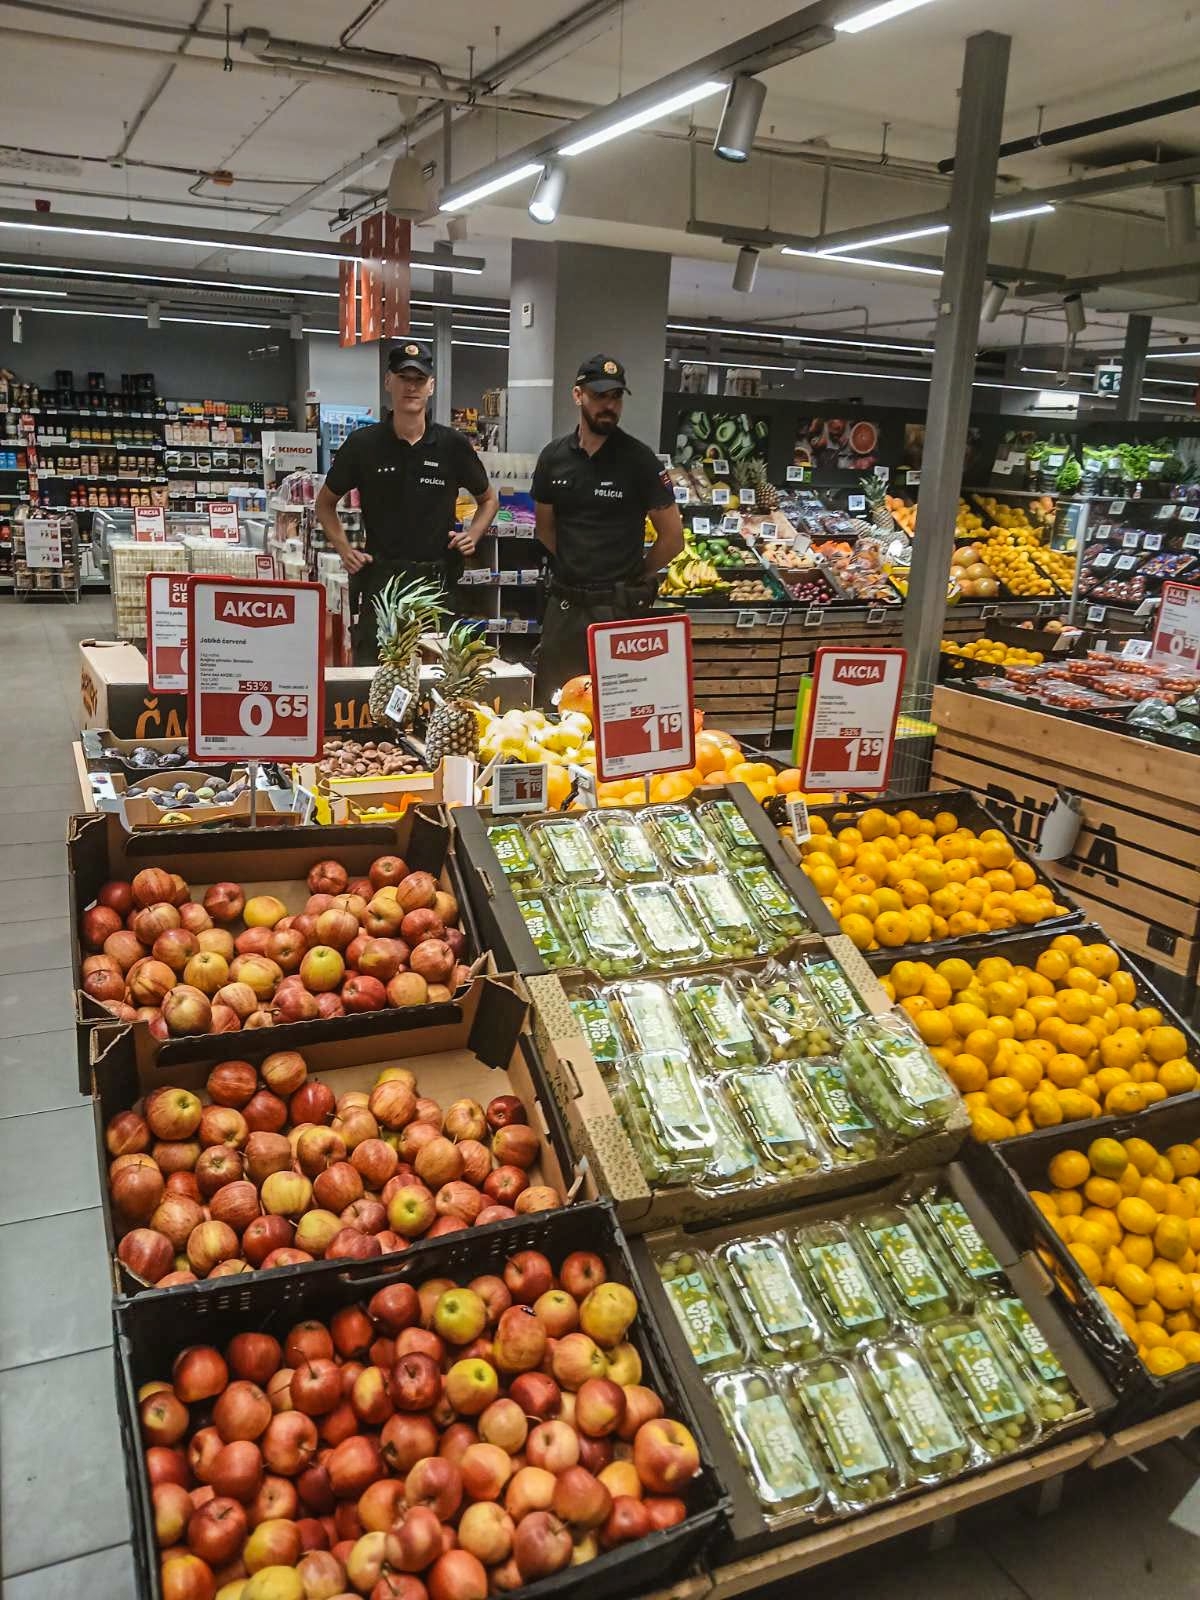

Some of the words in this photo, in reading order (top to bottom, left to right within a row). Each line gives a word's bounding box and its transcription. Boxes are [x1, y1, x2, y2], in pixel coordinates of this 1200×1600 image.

[420, 477, 445, 486] POLÍCIA
[594, 488, 623, 498] POLÍCIA
[222, 600, 288, 619] AKCIA
[616, 637, 664, 655] AKCIA
[1170, 635, 1183, 655] 0
[837, 665, 880, 679] AKCIA
[240, 681, 268, 691] -53%
[136, 697, 188, 739] ČA
[239, 693, 273, 737] 0
[275, 695, 308, 718] 65
[631, 705, 654, 716] -54%
[642, 715, 660, 752] 1
[660, 713, 682, 734] 19
[844, 739, 860, 772] 1
[860, 739, 883, 756] 39
[531, 782, 542, 792] 19
[985, 783, 1119, 889] BIA
